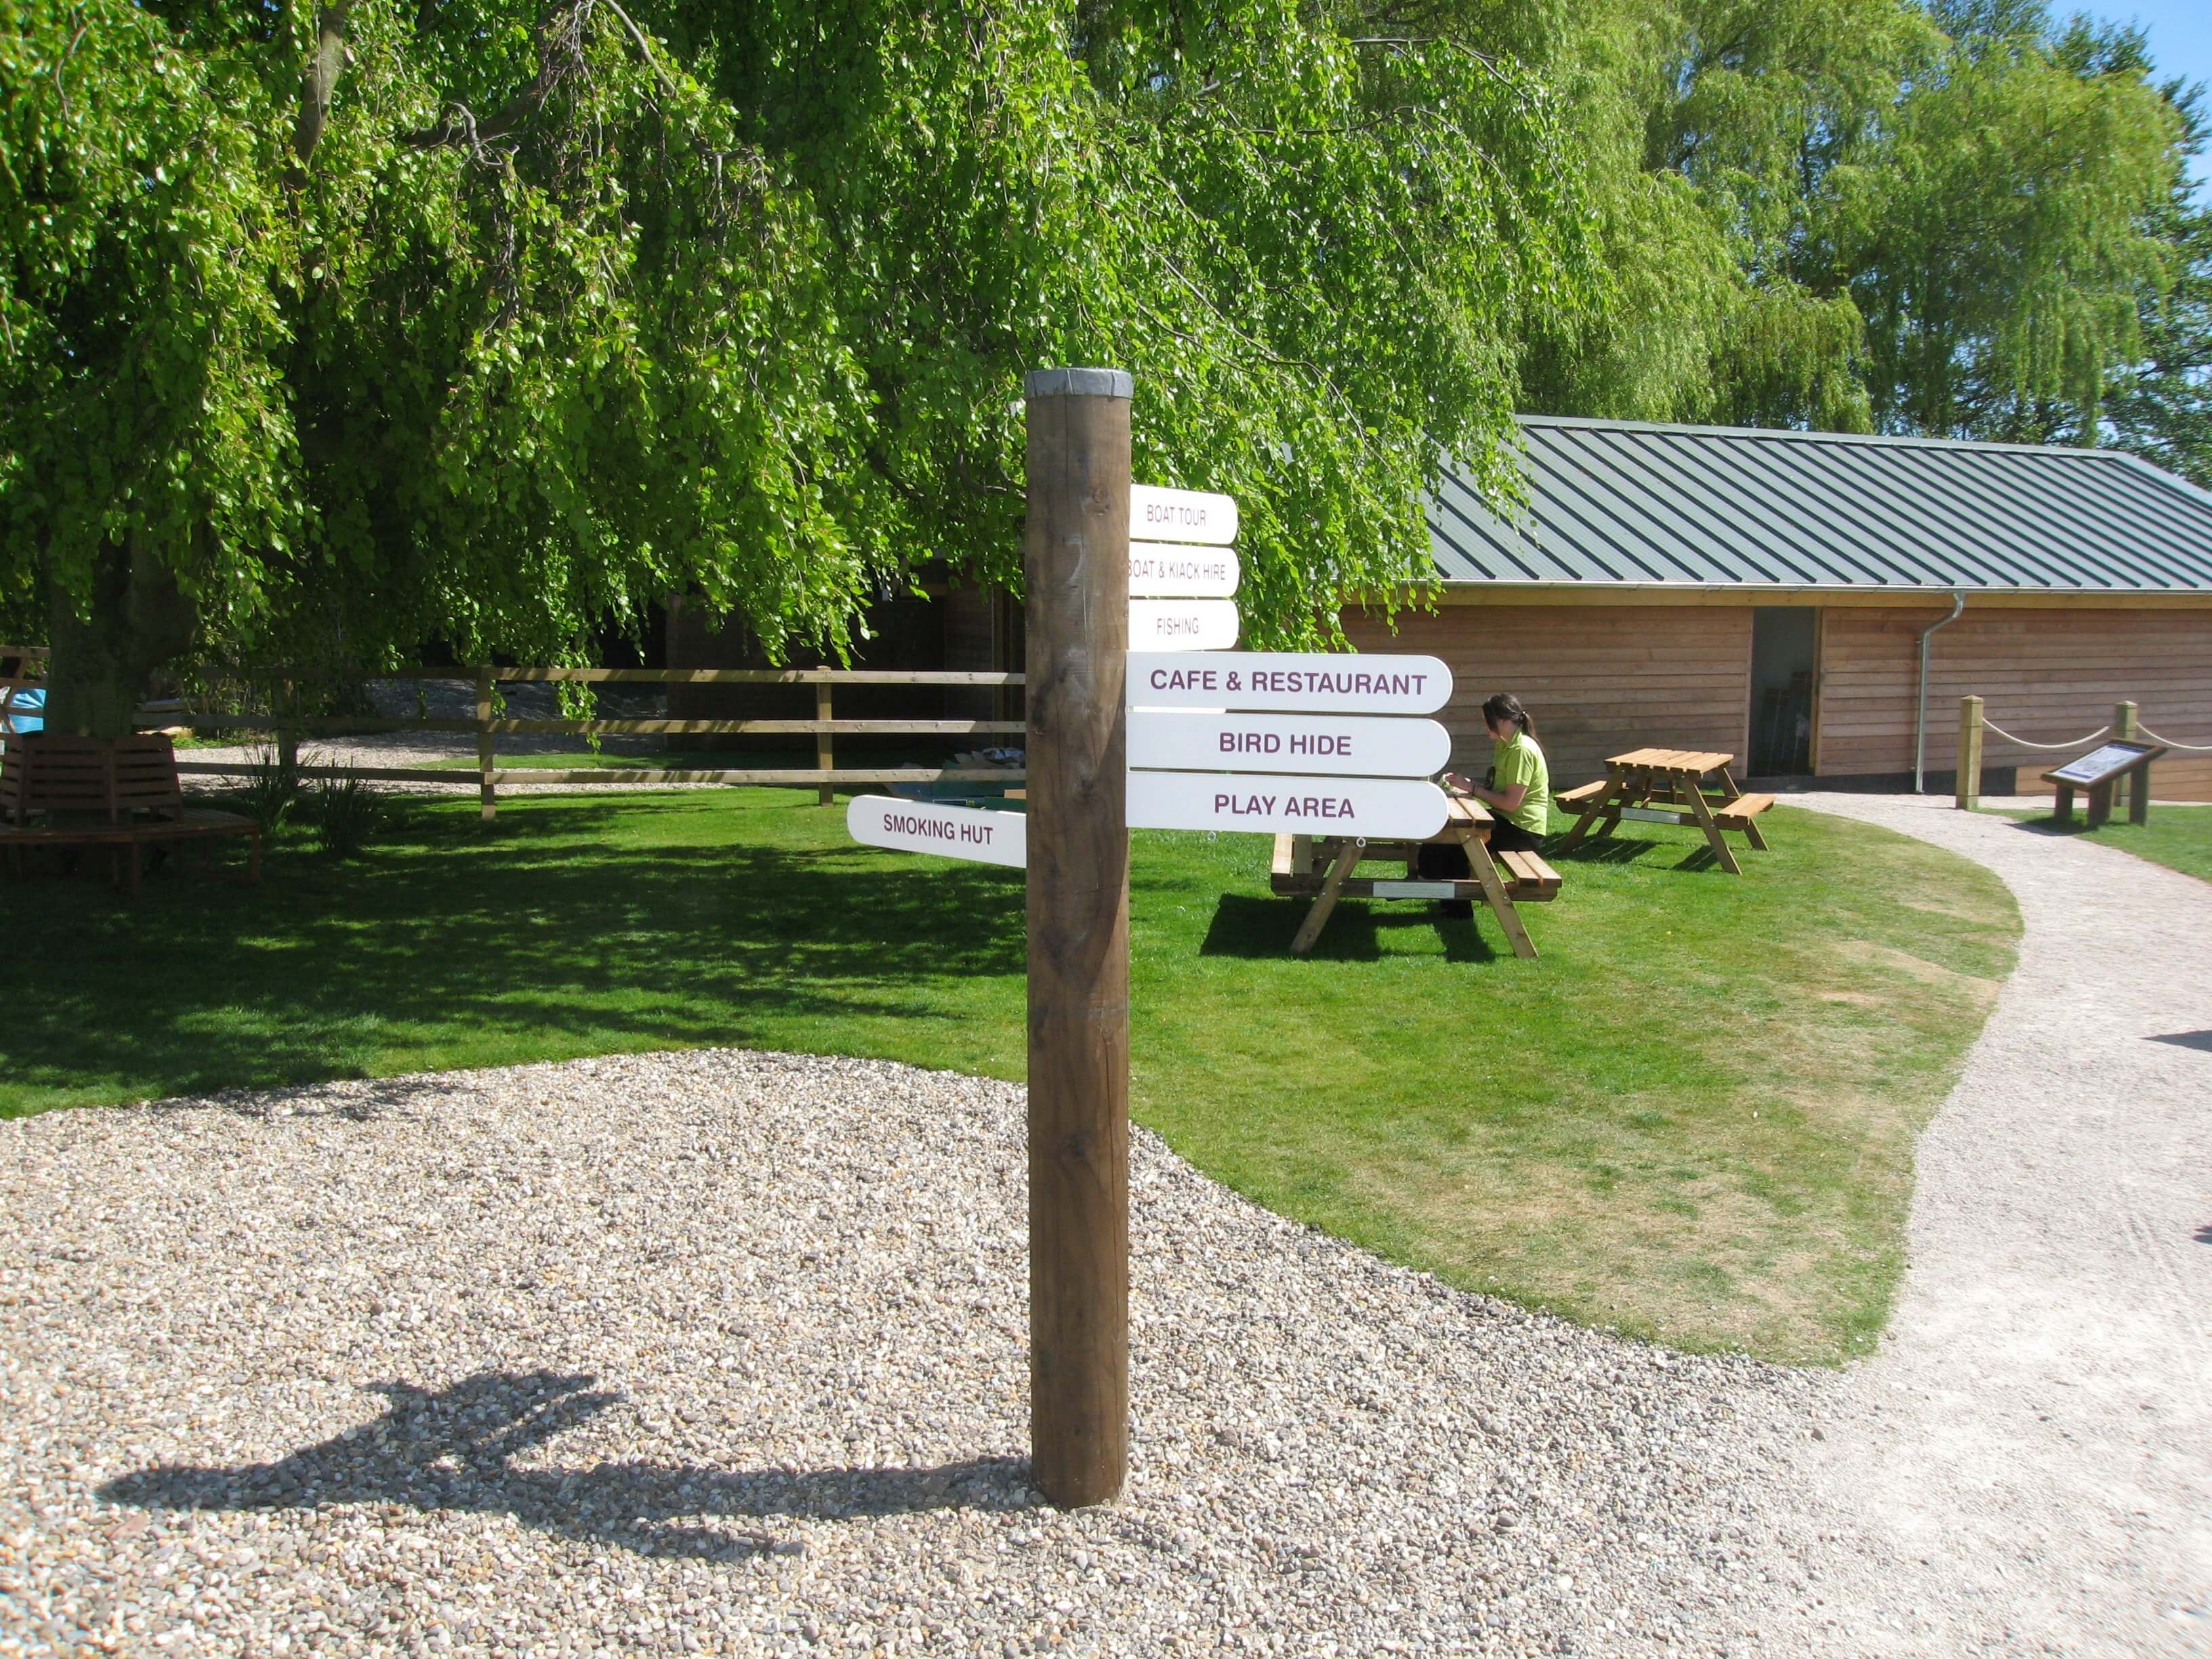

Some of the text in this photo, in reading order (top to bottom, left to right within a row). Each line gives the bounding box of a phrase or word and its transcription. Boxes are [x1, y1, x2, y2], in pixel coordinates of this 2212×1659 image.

[1147, 504, 1206, 526] BOAT TOUR
[1159, 560, 1165, 578] &
[1170, 561, 1200, 579] KIACK
[1203, 563, 1225, 581] HIRE
[1157, 617, 1199, 635] FISHING
[1151, 669, 1427, 695] CAFE & RESTAURANT
[1219, 733, 1352, 756] BIRD HIDE
[1214, 794, 1355, 819] PLAY AREA
[883, 814, 994, 845] SMOKING HUT
